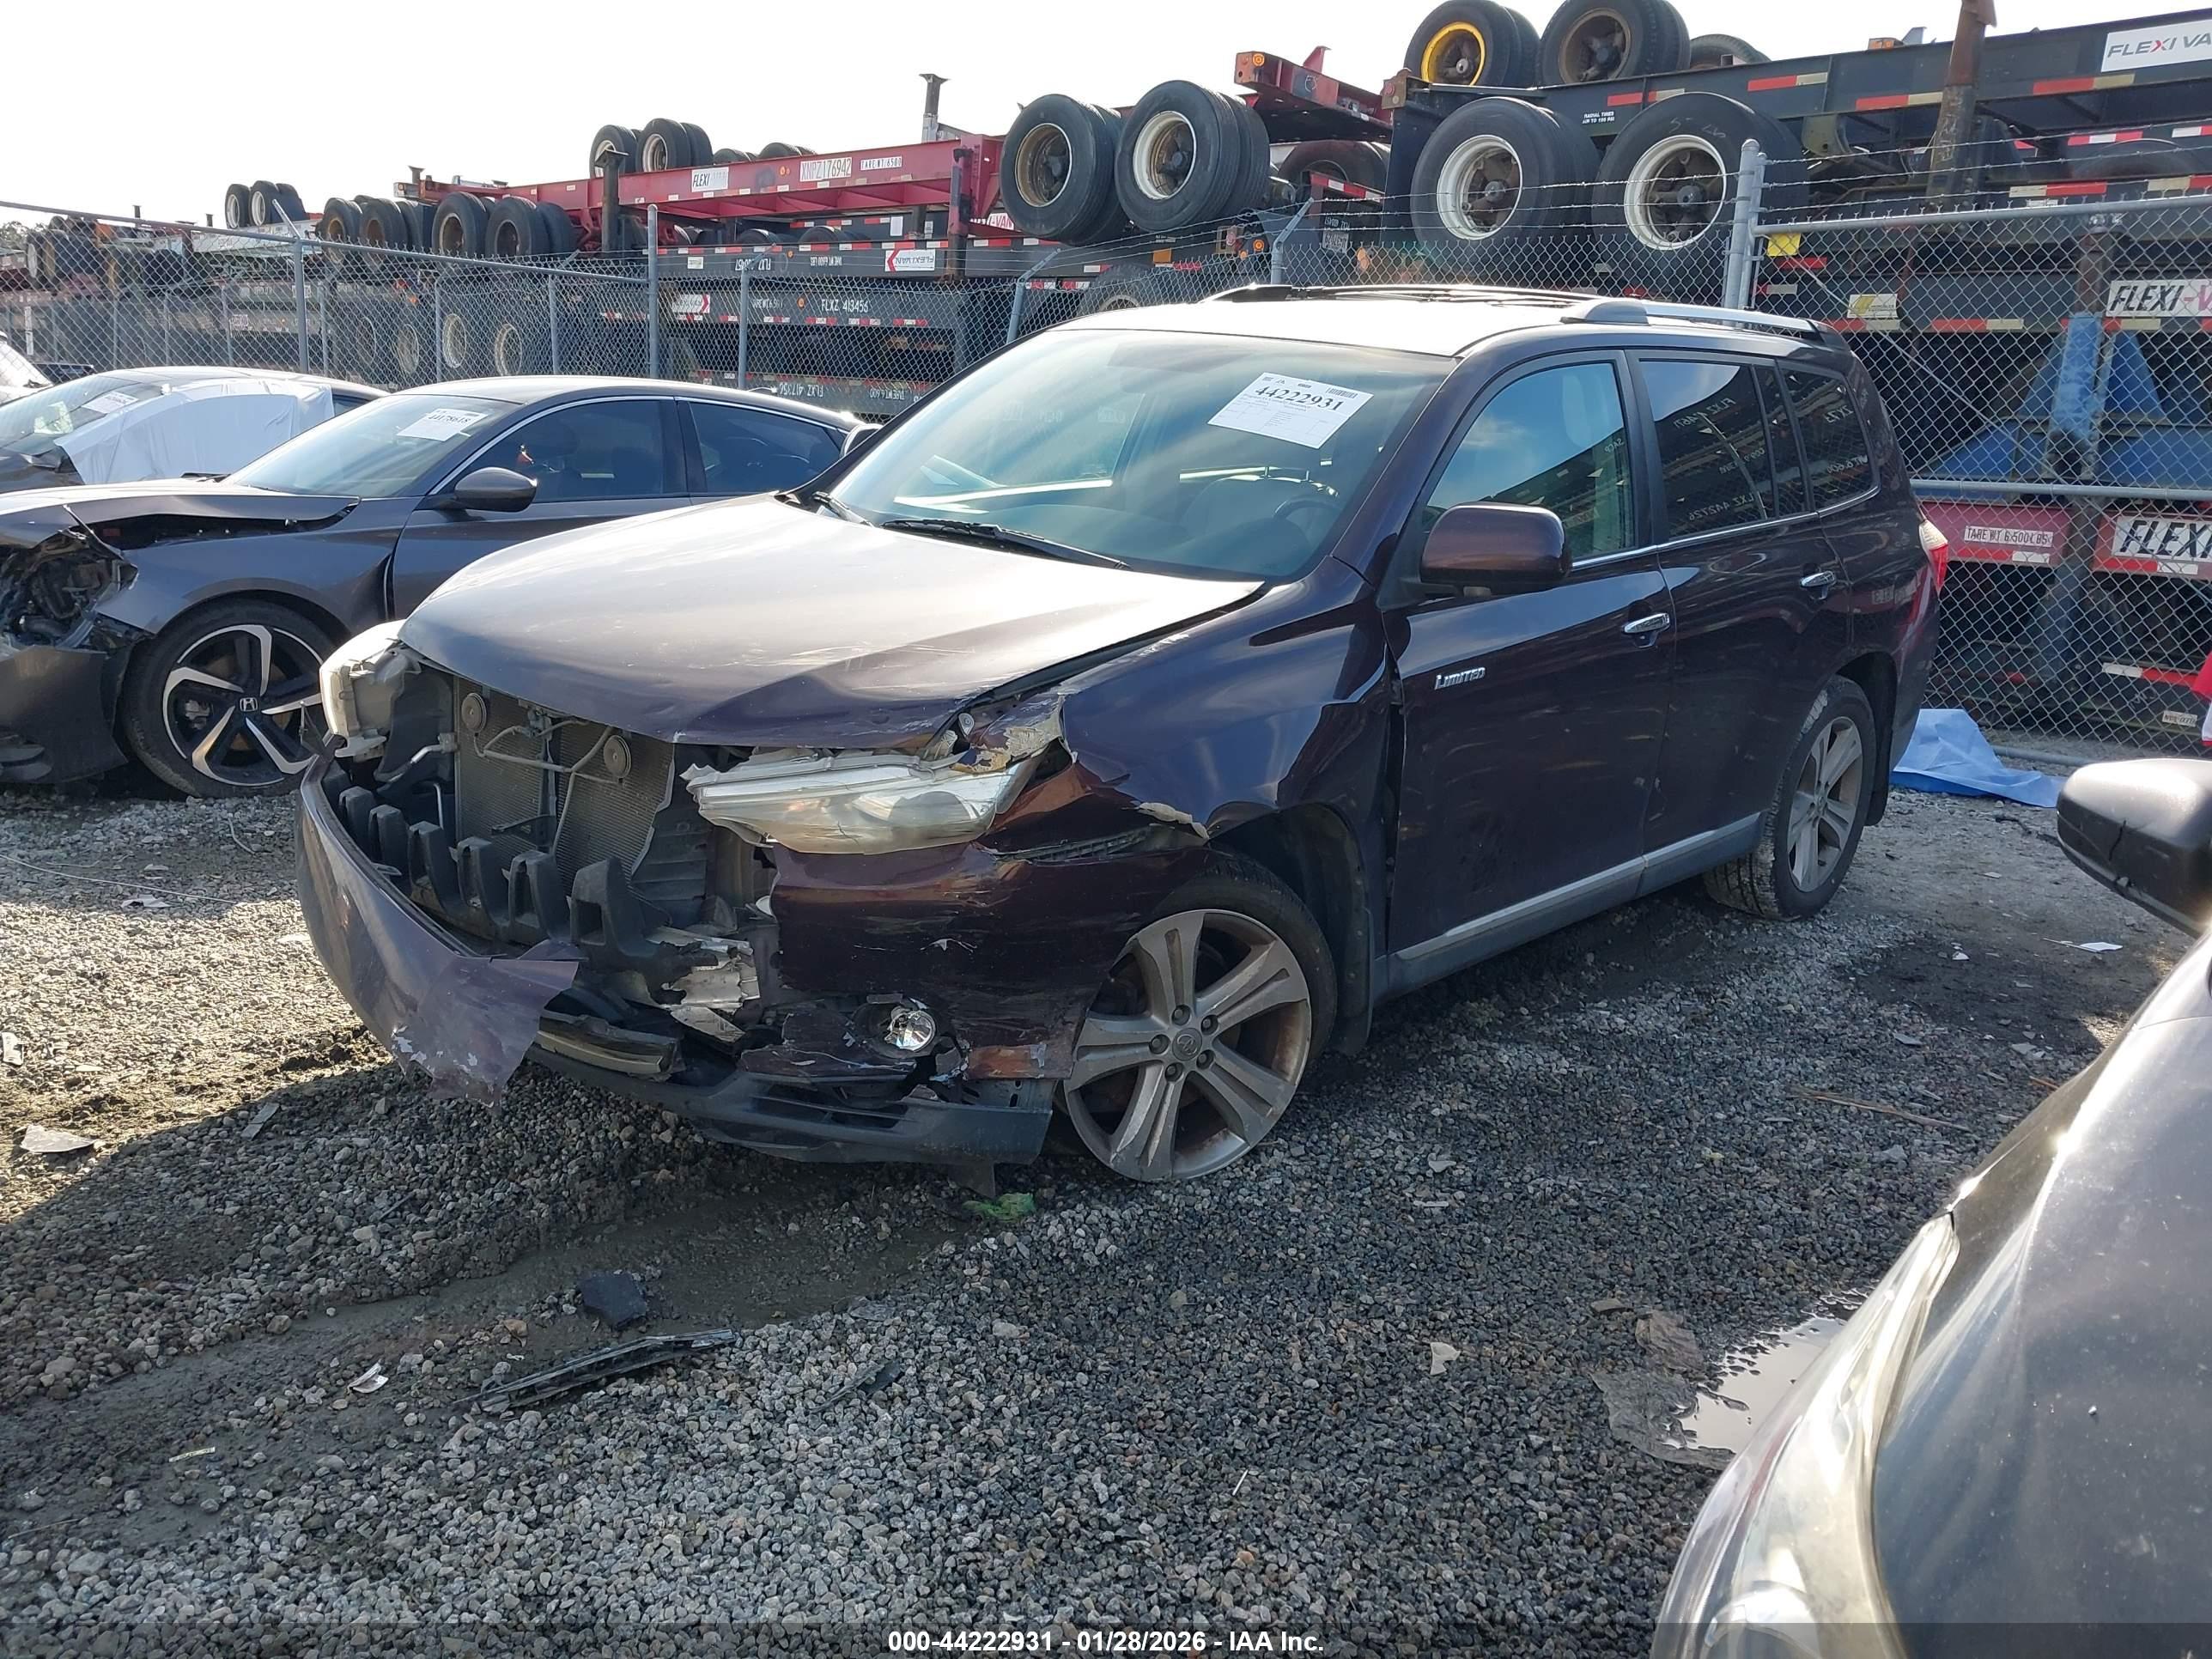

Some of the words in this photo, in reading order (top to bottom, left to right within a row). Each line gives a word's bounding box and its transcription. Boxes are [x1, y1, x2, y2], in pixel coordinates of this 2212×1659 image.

[2107, 37, 2178, 58] FLEXI
[692, 173, 711, 188] FLEXI
[821, 299, 839, 312] FLXZ
[2109, 283, 2212, 312] FLEXI-V
[1255, 386, 1345, 411] 44222931
